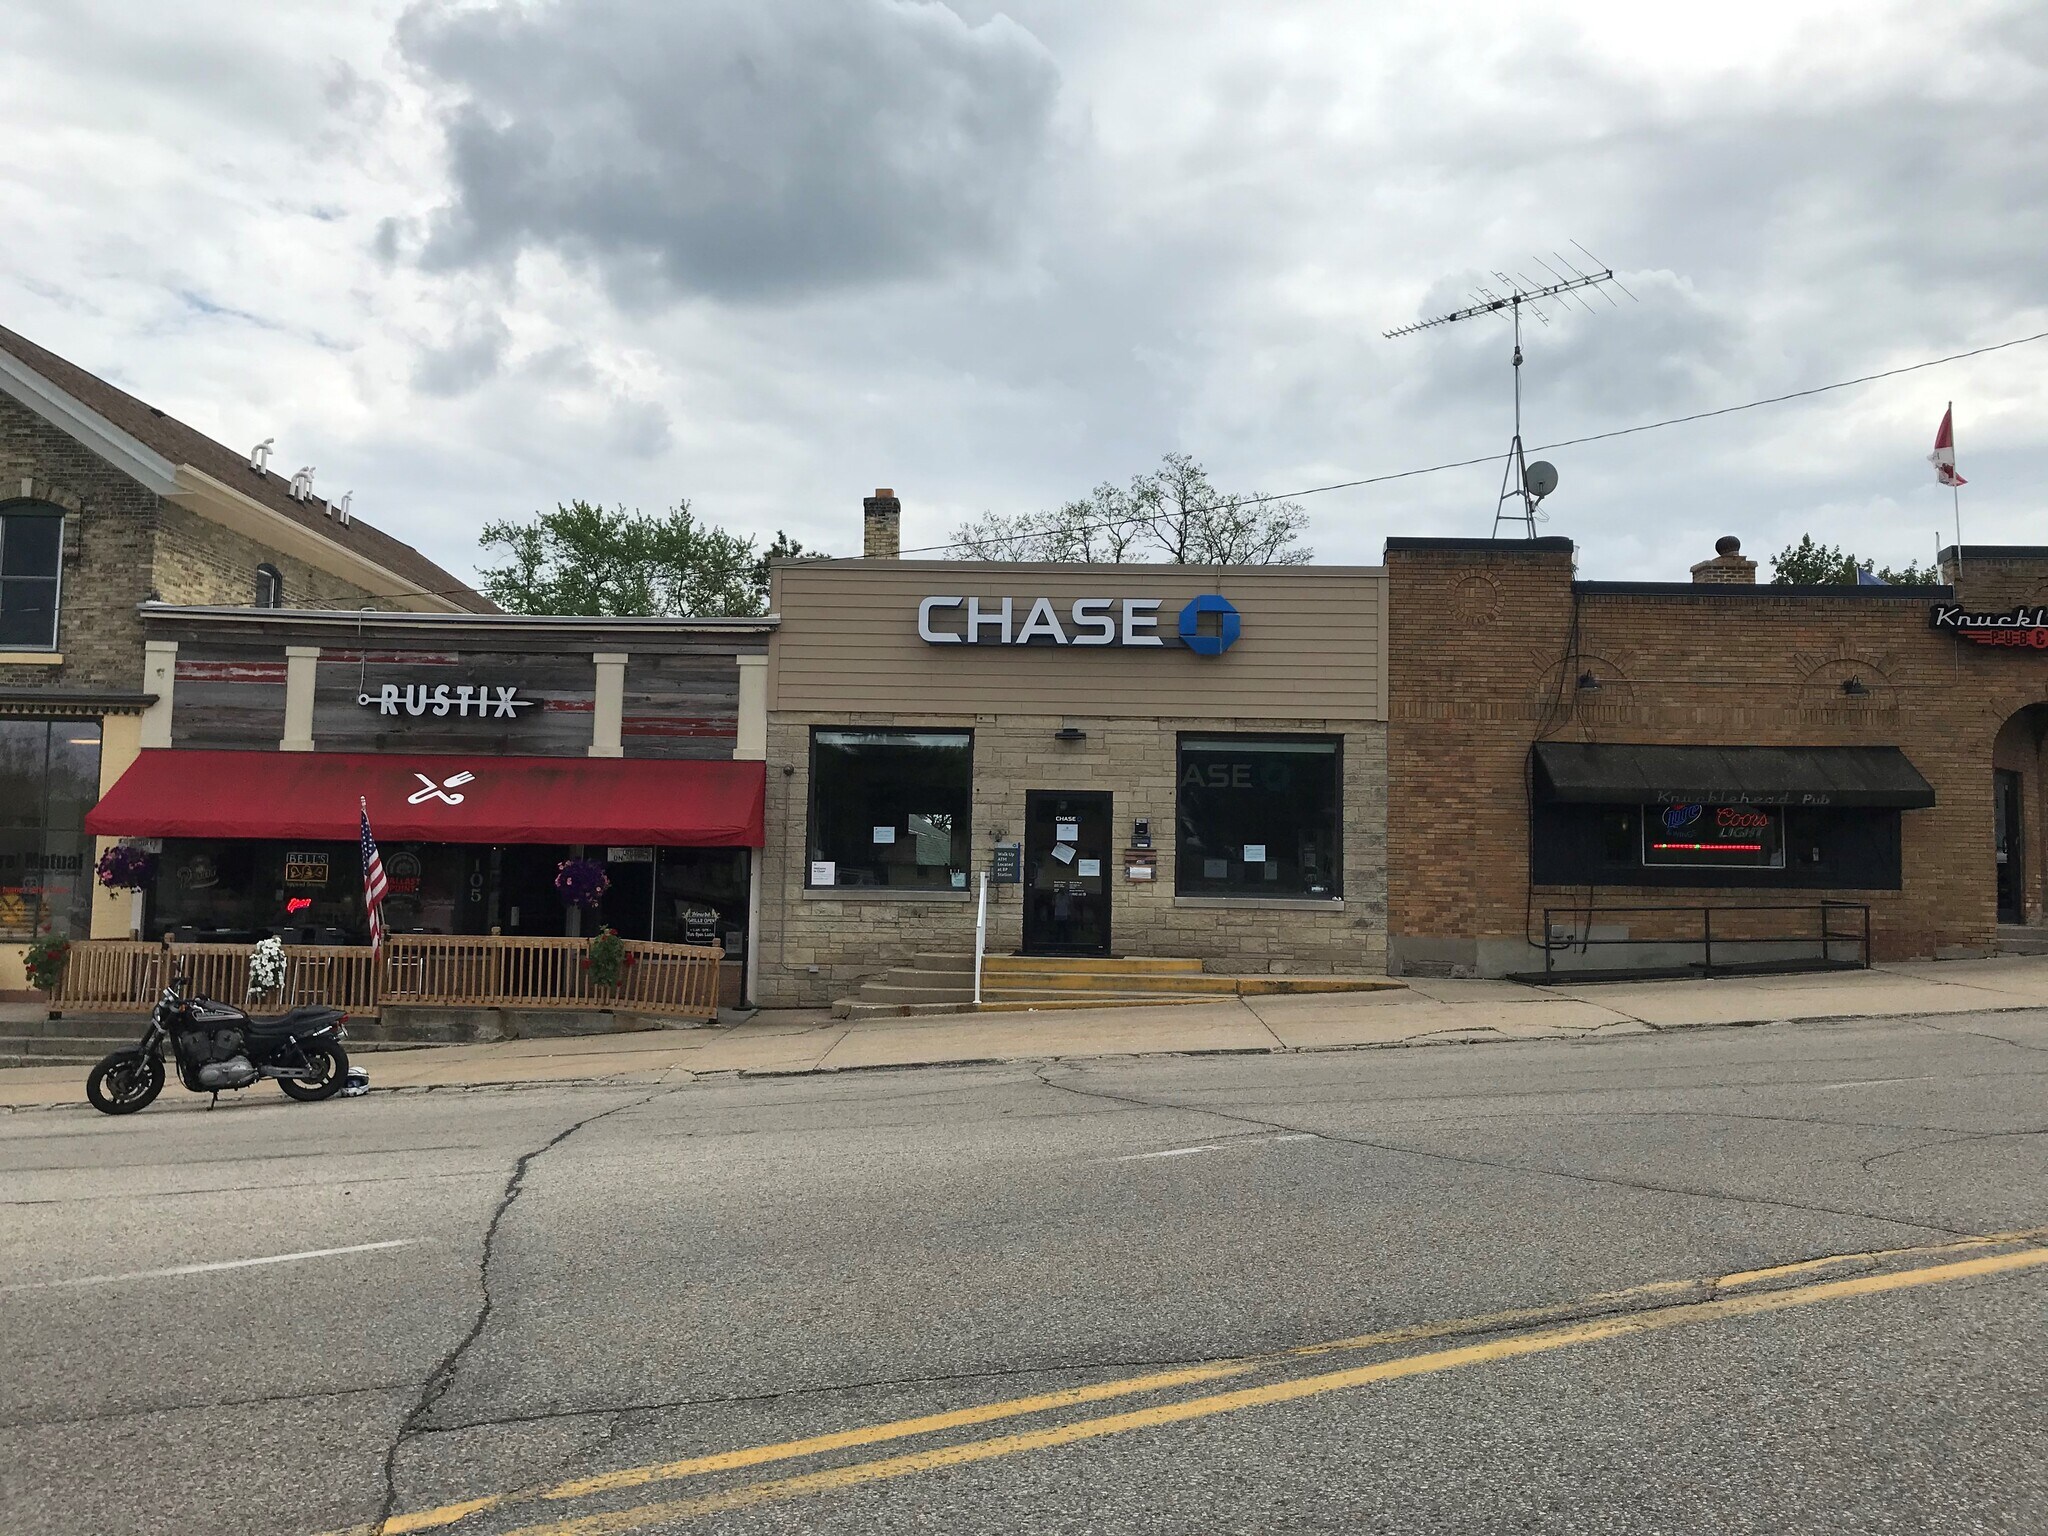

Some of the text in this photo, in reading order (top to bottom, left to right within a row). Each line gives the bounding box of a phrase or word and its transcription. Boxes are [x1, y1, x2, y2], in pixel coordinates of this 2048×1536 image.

[918, 596, 1164, 645] CHASE
[1936, 607, 2048, 627] Knuckl
[1991, 630, 2028, 646] PUB
[380, 684, 518, 718] RUSTIX
[1802, 794, 1831, 804] Pub
[1716, 807, 1769, 828] Coors
[1719, 827, 1764, 838] LIGHT
[24, 853, 83, 870] Mutual
[289, 854, 326, 864] BELL'S
[470, 858, 483, 902] 105
